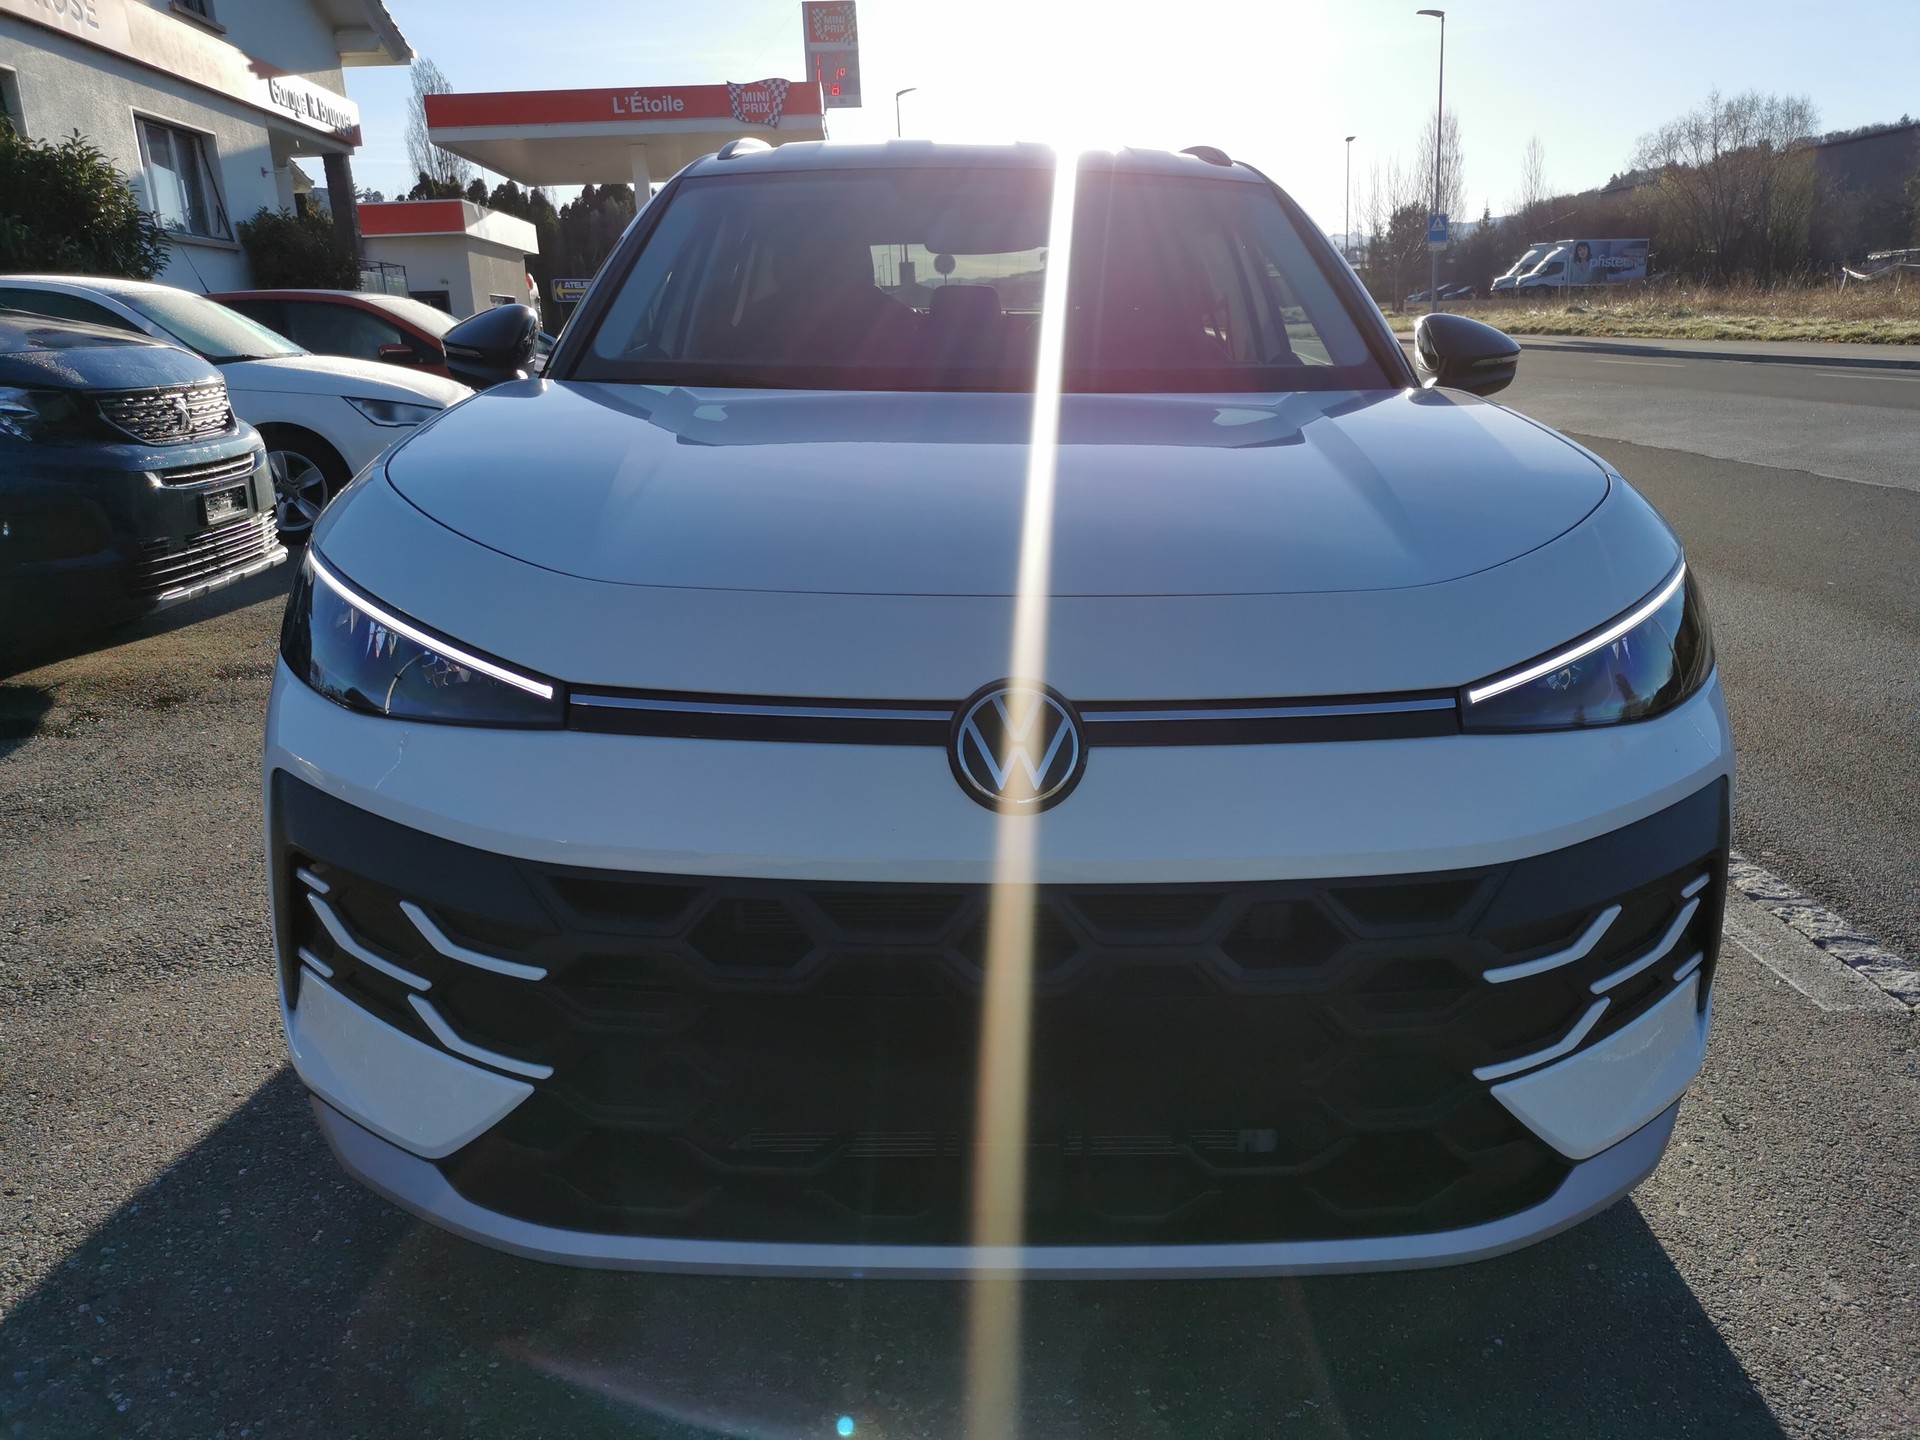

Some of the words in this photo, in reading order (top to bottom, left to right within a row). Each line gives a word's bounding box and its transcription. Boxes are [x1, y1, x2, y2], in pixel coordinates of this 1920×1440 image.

[34, 0, 99, 30] OSE
[823, 16, 846, 25] MINI
[824, 24, 846, 33] PRIX
[267, 76, 307, 119] Garage
[612, 92, 685, 114] L'Étoile
[742, 91, 770, 103] MINI
[742, 102, 771, 114] PRIX
[1590, 254, 1626, 271] pfister
